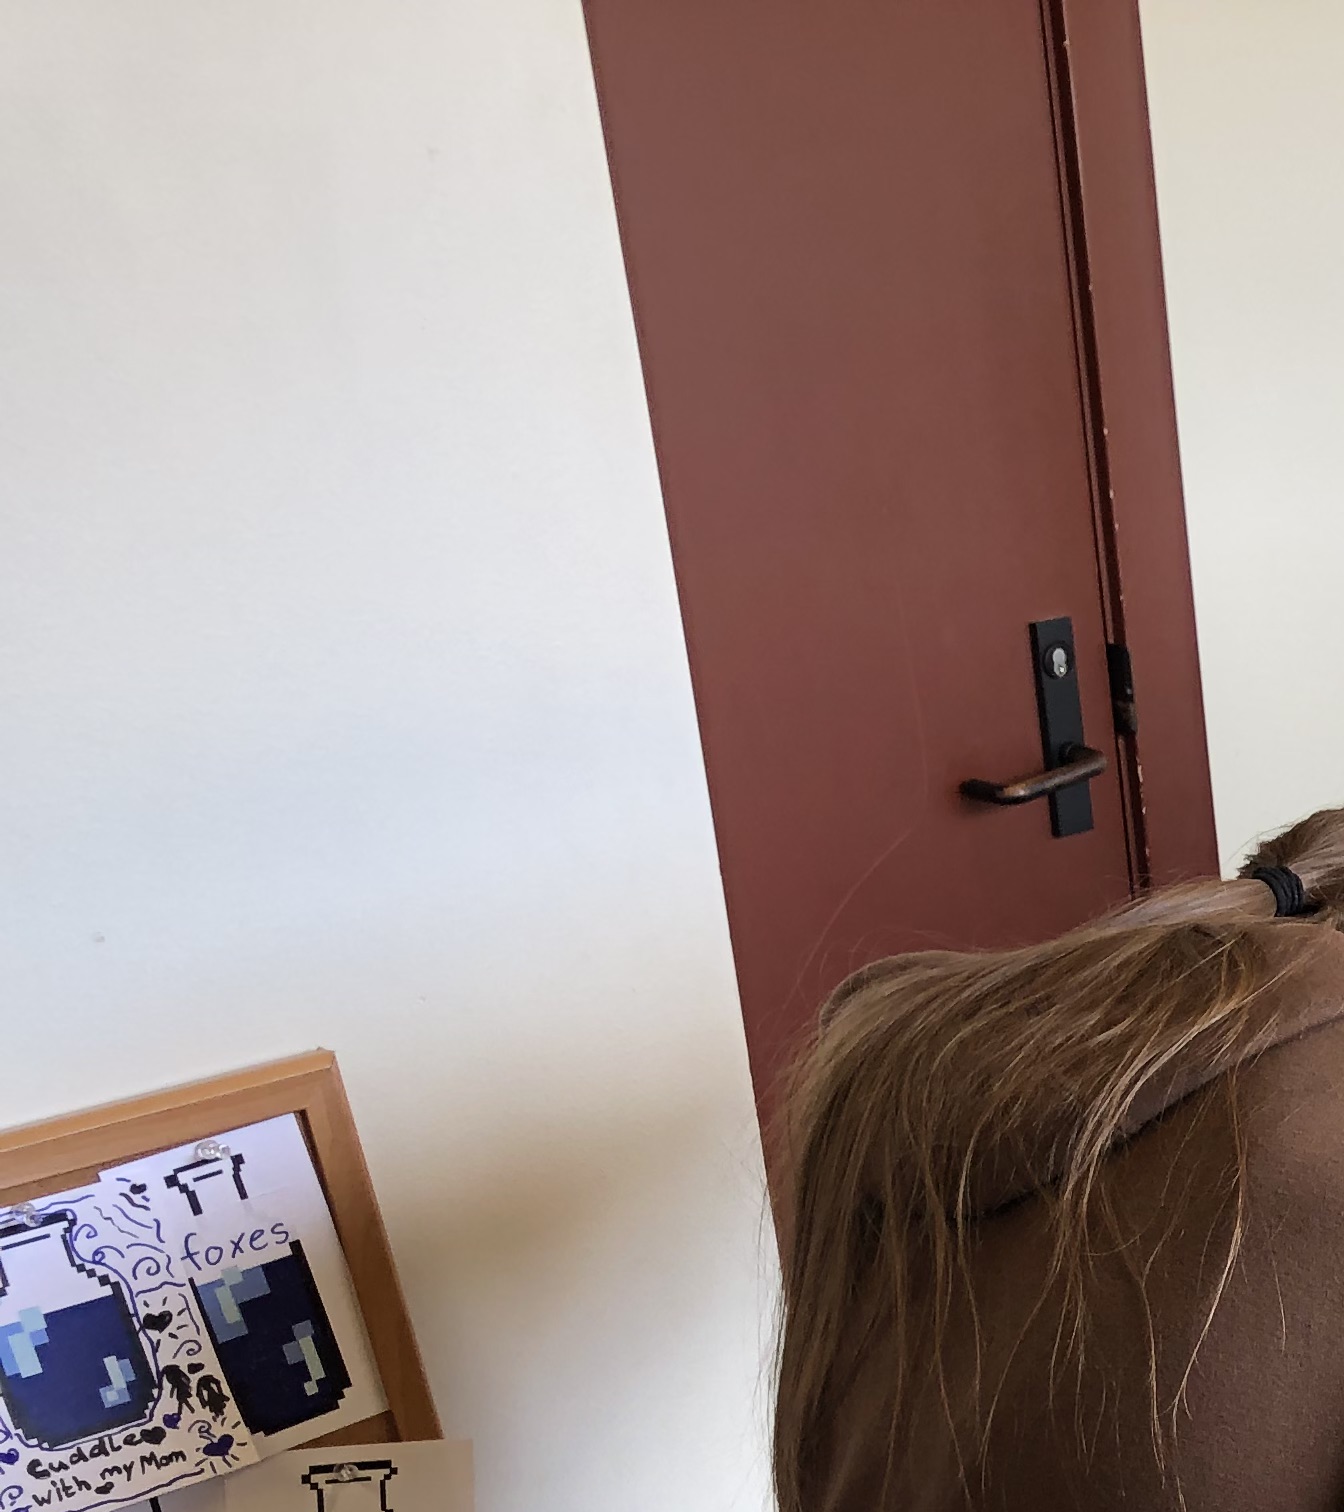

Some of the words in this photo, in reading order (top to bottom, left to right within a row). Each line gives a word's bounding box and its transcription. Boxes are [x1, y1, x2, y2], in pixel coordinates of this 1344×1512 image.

[32, 1476, 92, 1507] with
[100, 1461, 134, 1482] my
[140, 1451, 187, 1475] Mom
